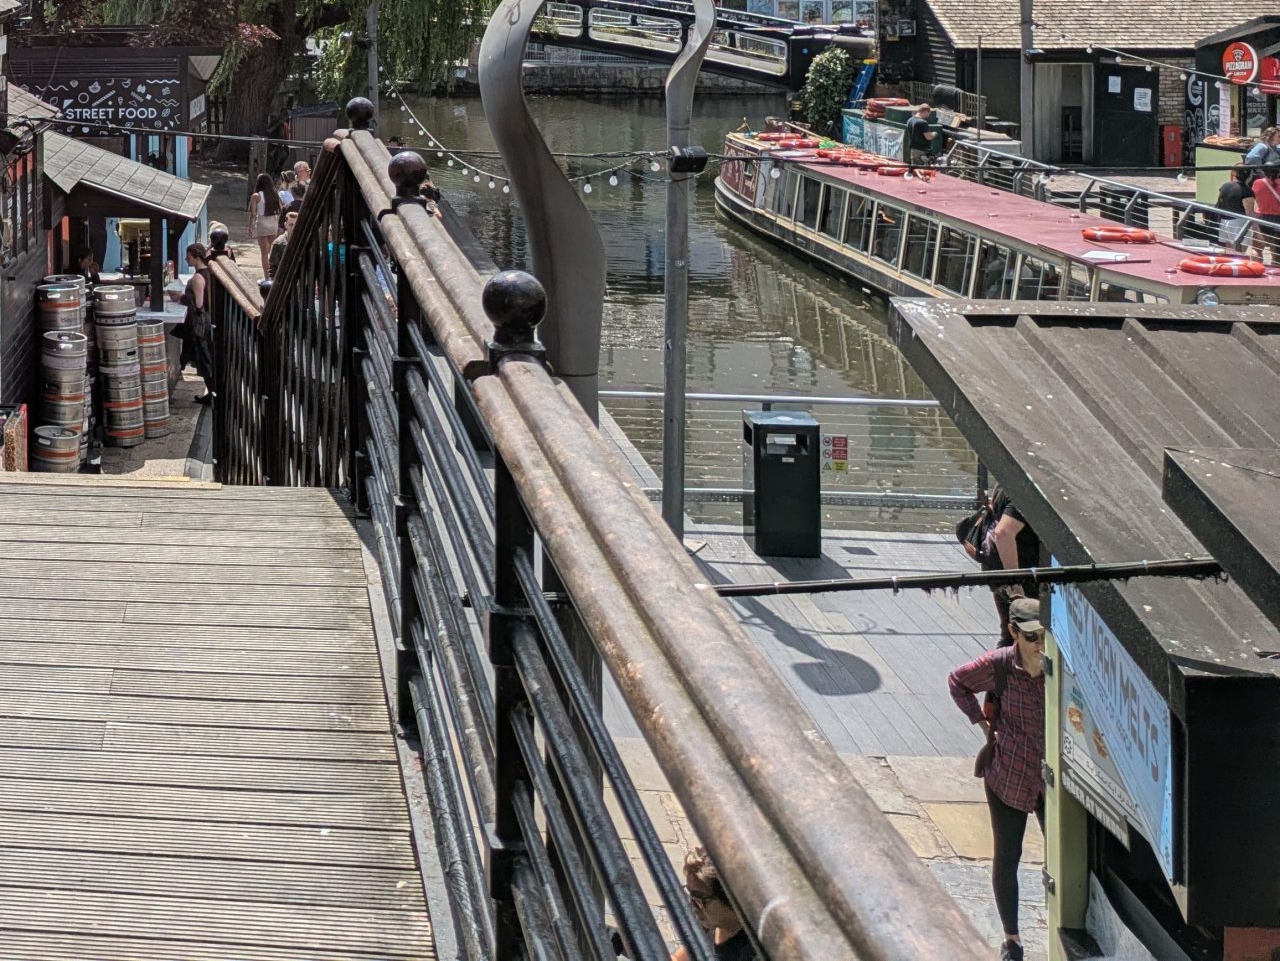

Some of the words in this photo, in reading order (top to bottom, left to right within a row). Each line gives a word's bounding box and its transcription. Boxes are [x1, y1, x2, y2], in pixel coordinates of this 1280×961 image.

[65, 107, 115, 120] STREET
[118, 107, 158, 120] FOOD
[1091, 610, 1117, 705] NAAN
[1119, 659, 1160, 783] MELTS
